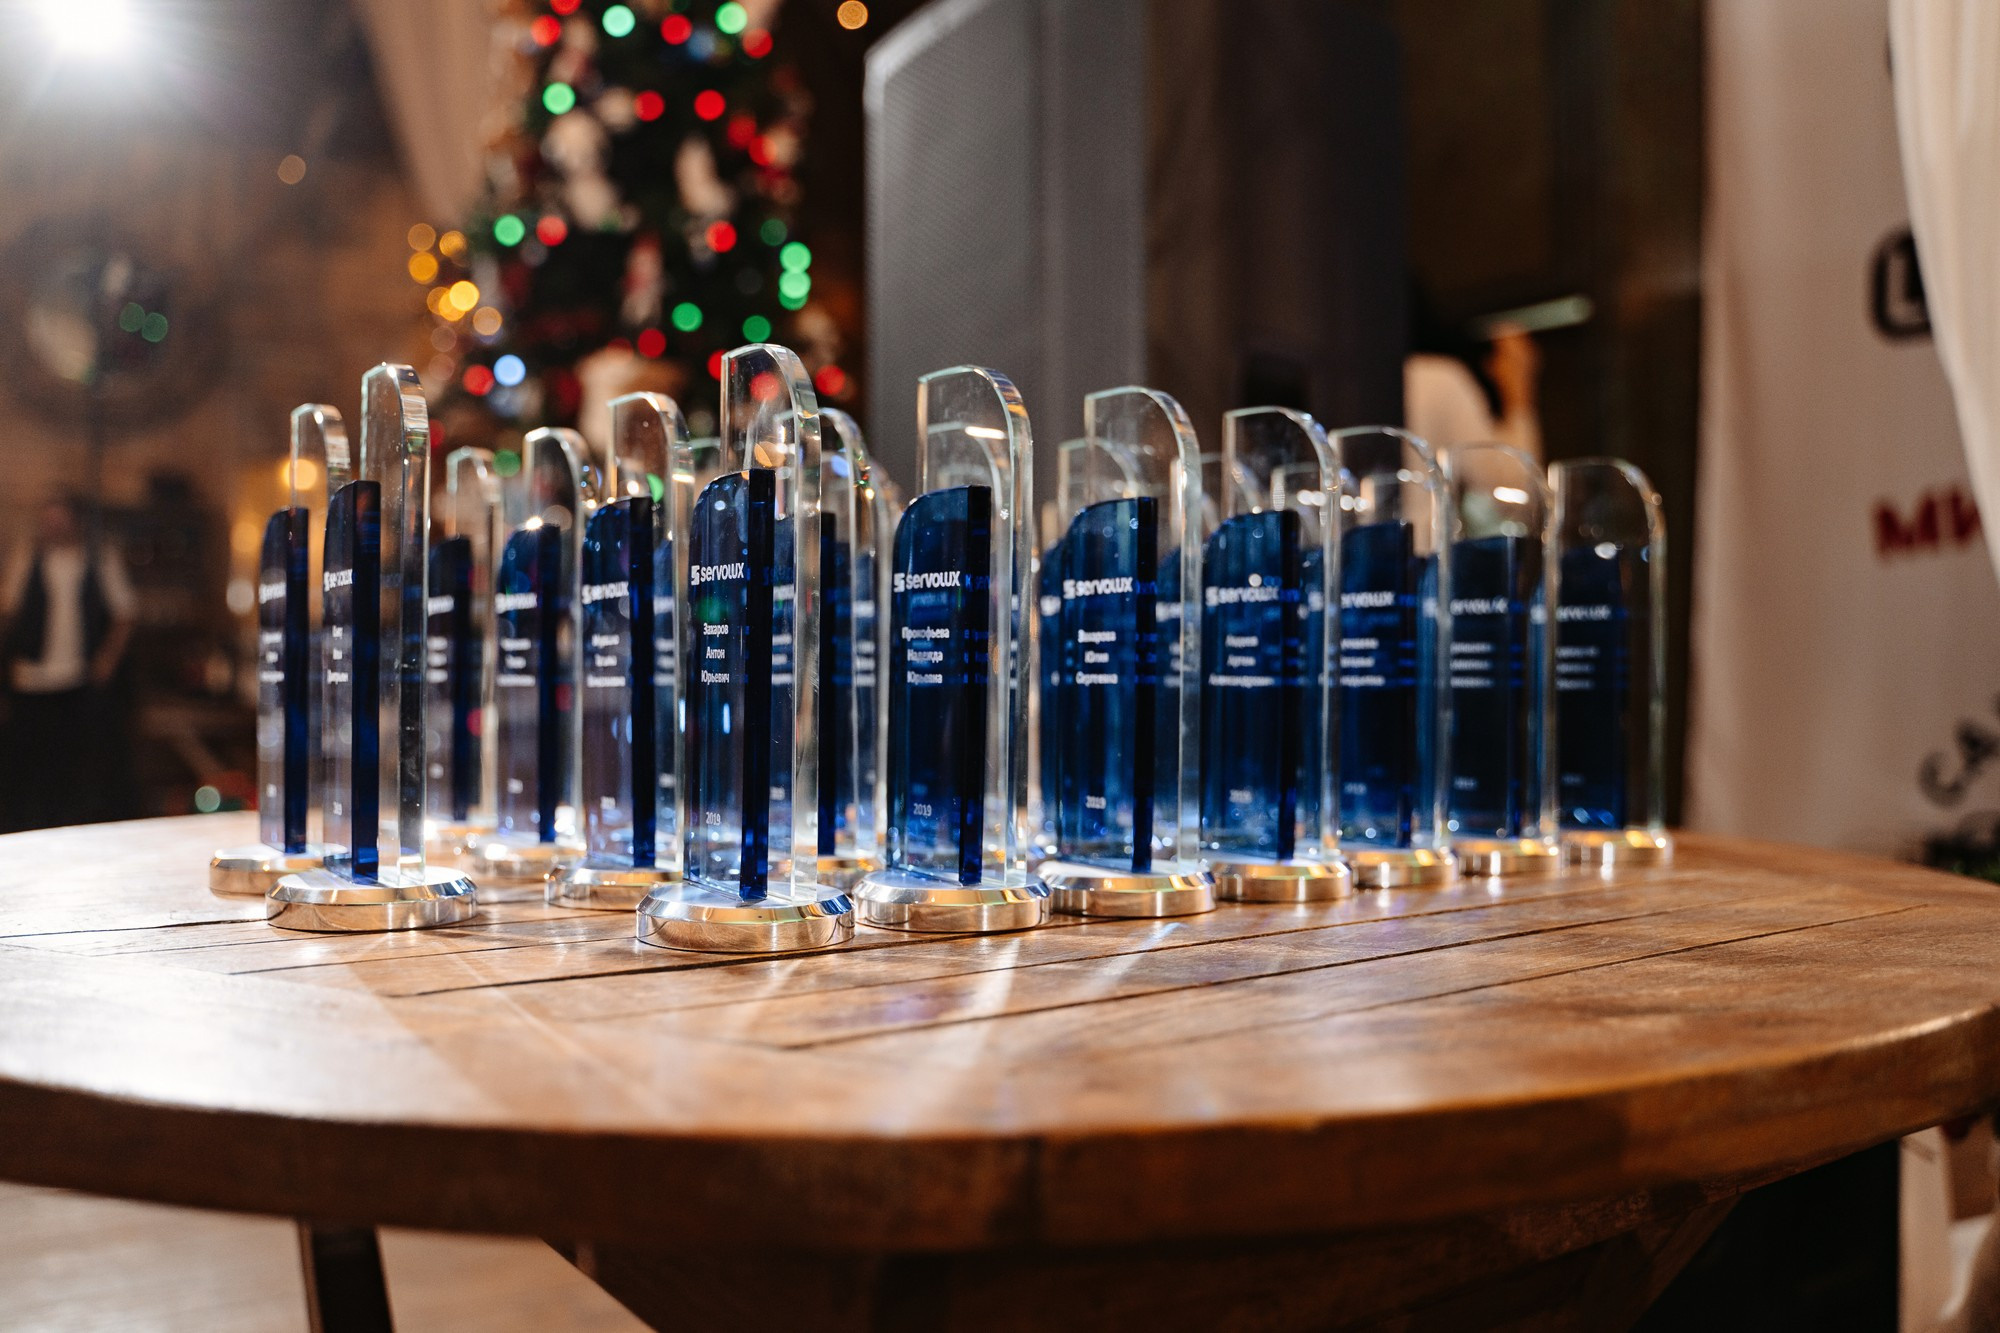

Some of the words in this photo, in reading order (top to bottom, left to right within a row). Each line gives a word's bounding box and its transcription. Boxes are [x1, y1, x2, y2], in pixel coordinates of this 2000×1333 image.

[700, 562, 745, 582] servolux
[905, 571, 961, 590] servolux
[1075, 577, 1133, 597] servolux
[703, 622, 729, 637] Захаров
[902, 626, 950, 641] Прокофьева
[705, 646, 726, 659] Антон
[907, 648, 944, 664] Надежда
[700, 669, 730, 685] Юрьевич
[913, 802, 932, 817] 2019
[1085, 795, 1107, 810] 2019
[705, 811, 721, 826] 2019
